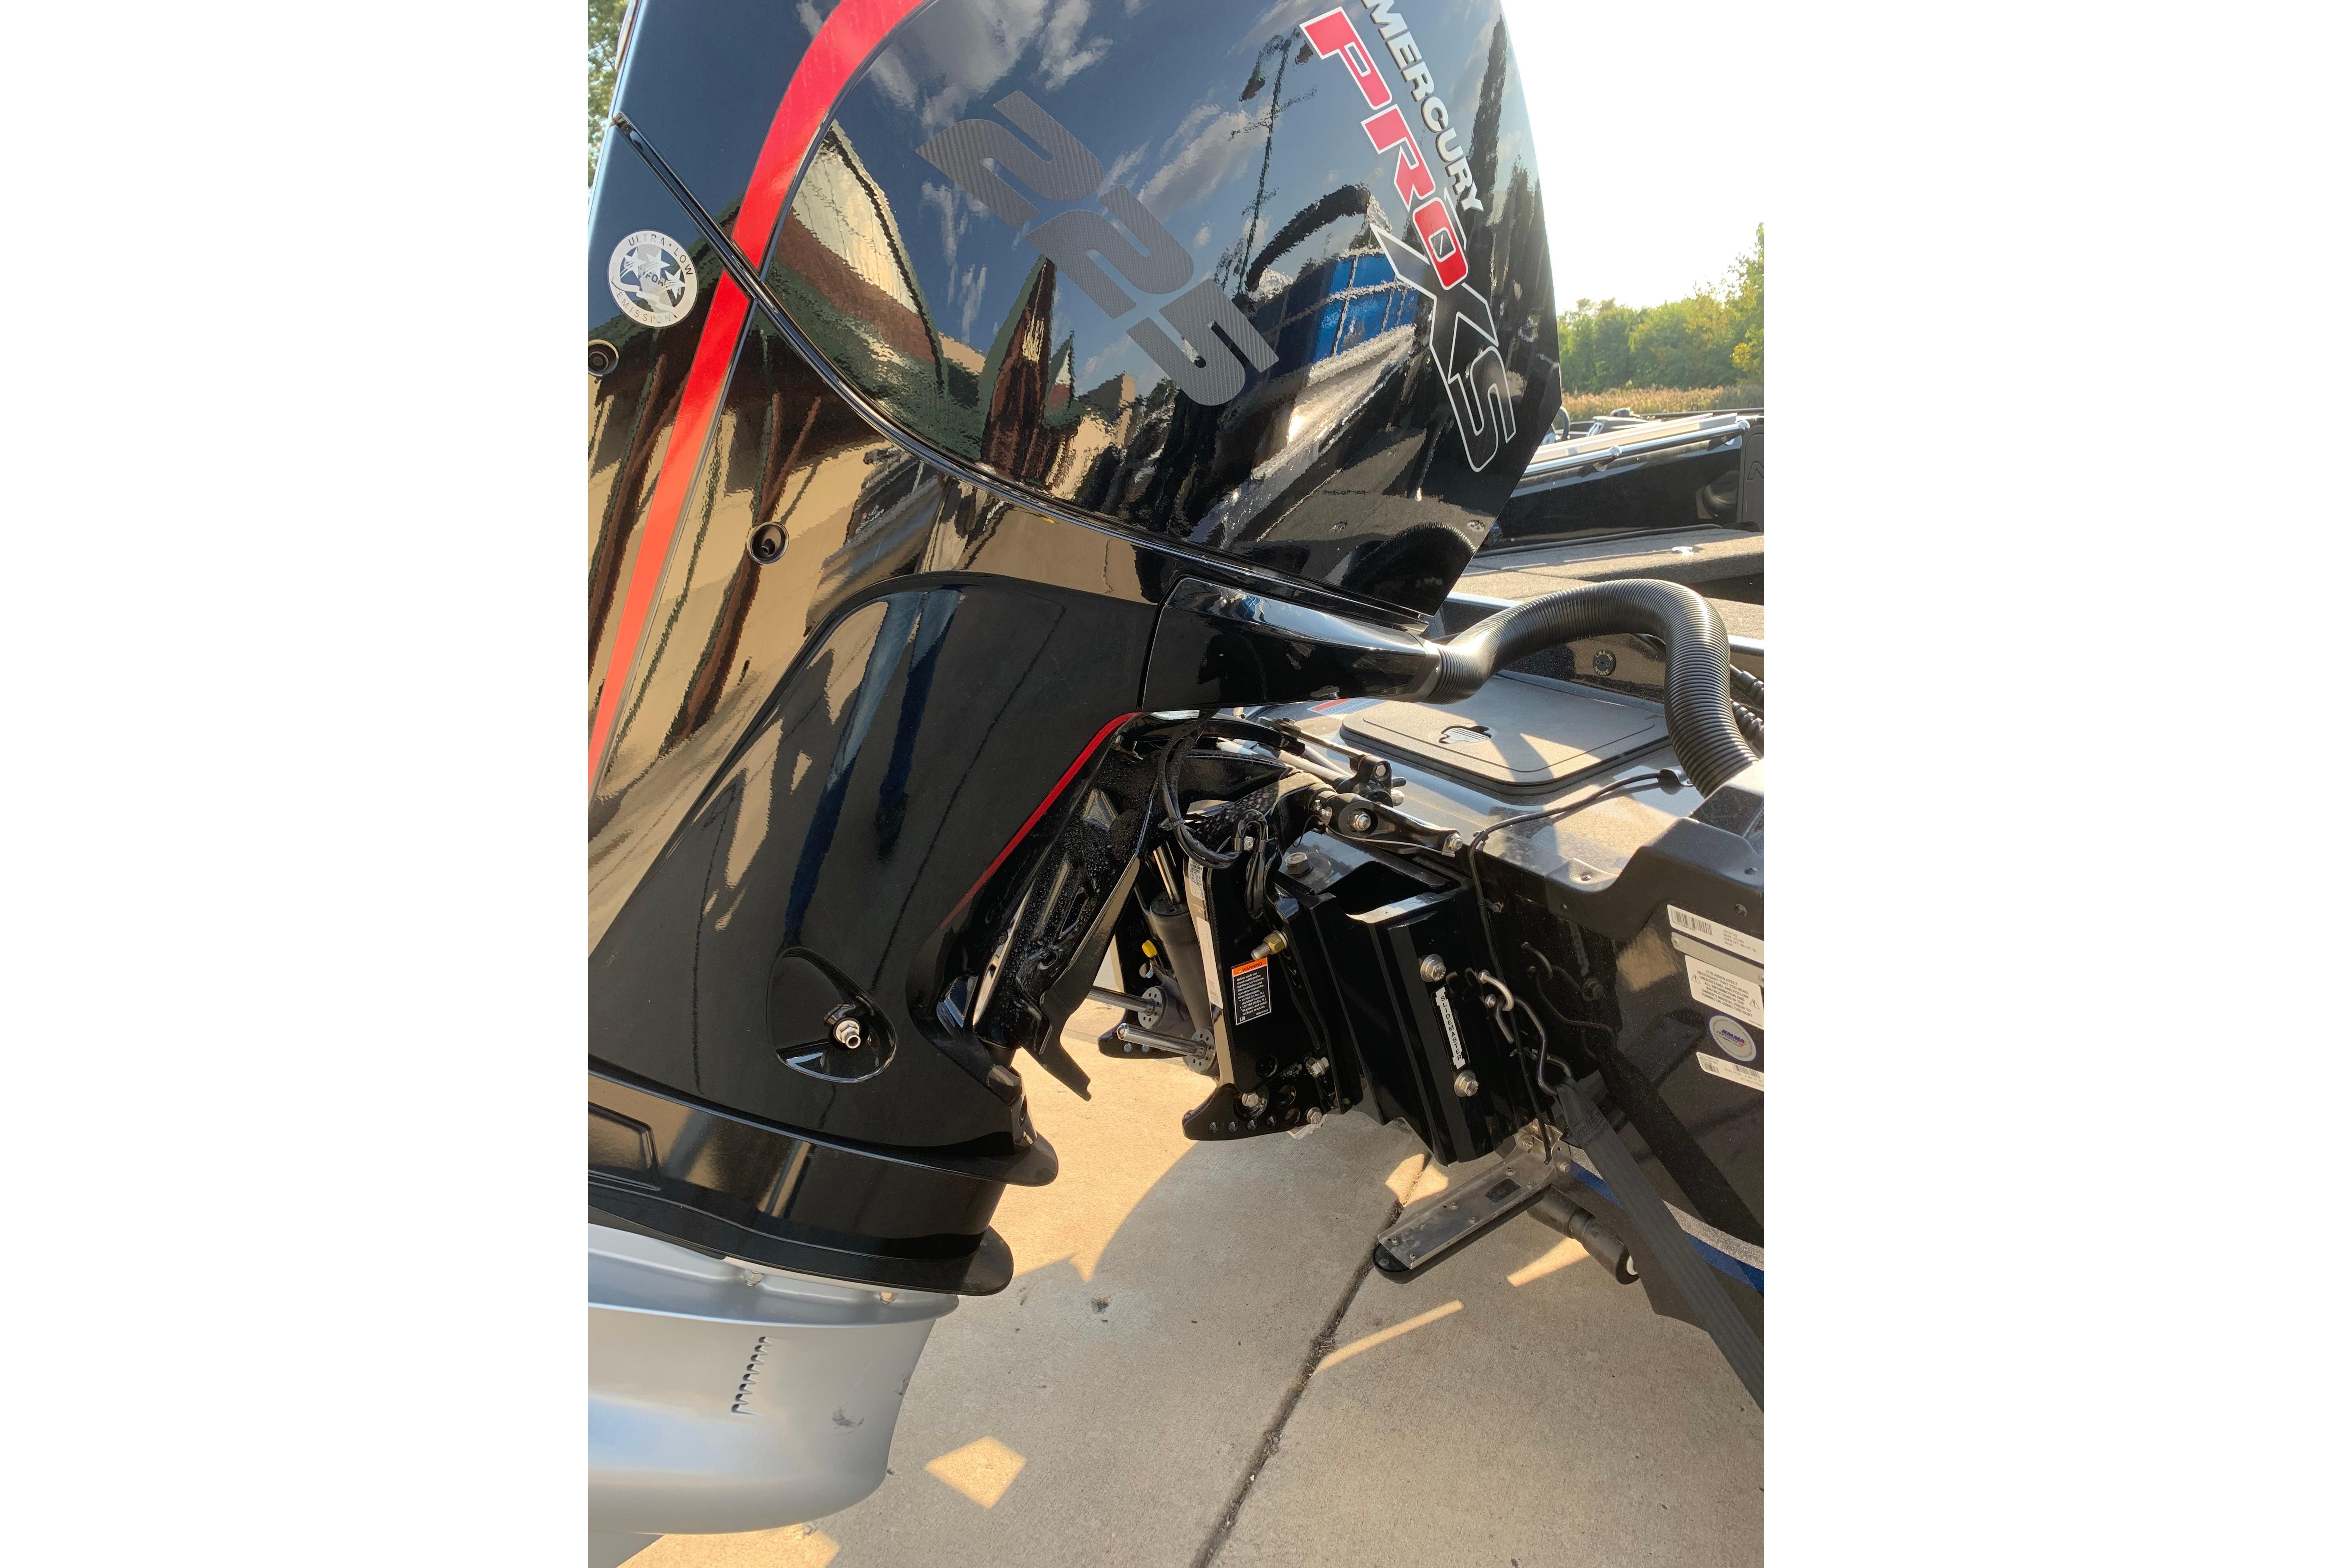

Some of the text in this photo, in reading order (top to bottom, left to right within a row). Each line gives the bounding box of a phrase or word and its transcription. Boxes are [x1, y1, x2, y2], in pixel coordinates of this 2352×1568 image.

[1360, 0, 1484, 213] MERCURY
[1299, 6, 1468, 290] PRO
[628, 233, 693, 275] ULTRA LOW
[916, 91, 1279, 406] 225
[1594, 666, 1609, 676] INTAKE
[1242, 962, 1262, 972] WARNING
[1697, 970, 1718, 982] NECESSARY
[1714, 973, 1738, 986] ABSOLUTELY
[1706, 986, 1732, 1000] INSTRUCTIONS
[1712, 985, 1736, 998] INFORMATION
[1732, 989, 1748, 999] FOLLOW
[1701, 988, 1717, 998] OWNER'S
[1718, 996, 1733, 1005] MANUAL
[1733, 1002, 1745, 1010] PRIOR
[1701, 992, 1715, 1001] TOWING
[1722, 1001, 1733, 1009] USING
[1440, 996, 1462, 1060] SLIDEMASTER
[1717, 1031, 1738, 1043] CERTIFIED
[1721, 1029, 1745, 1043] NMMA
